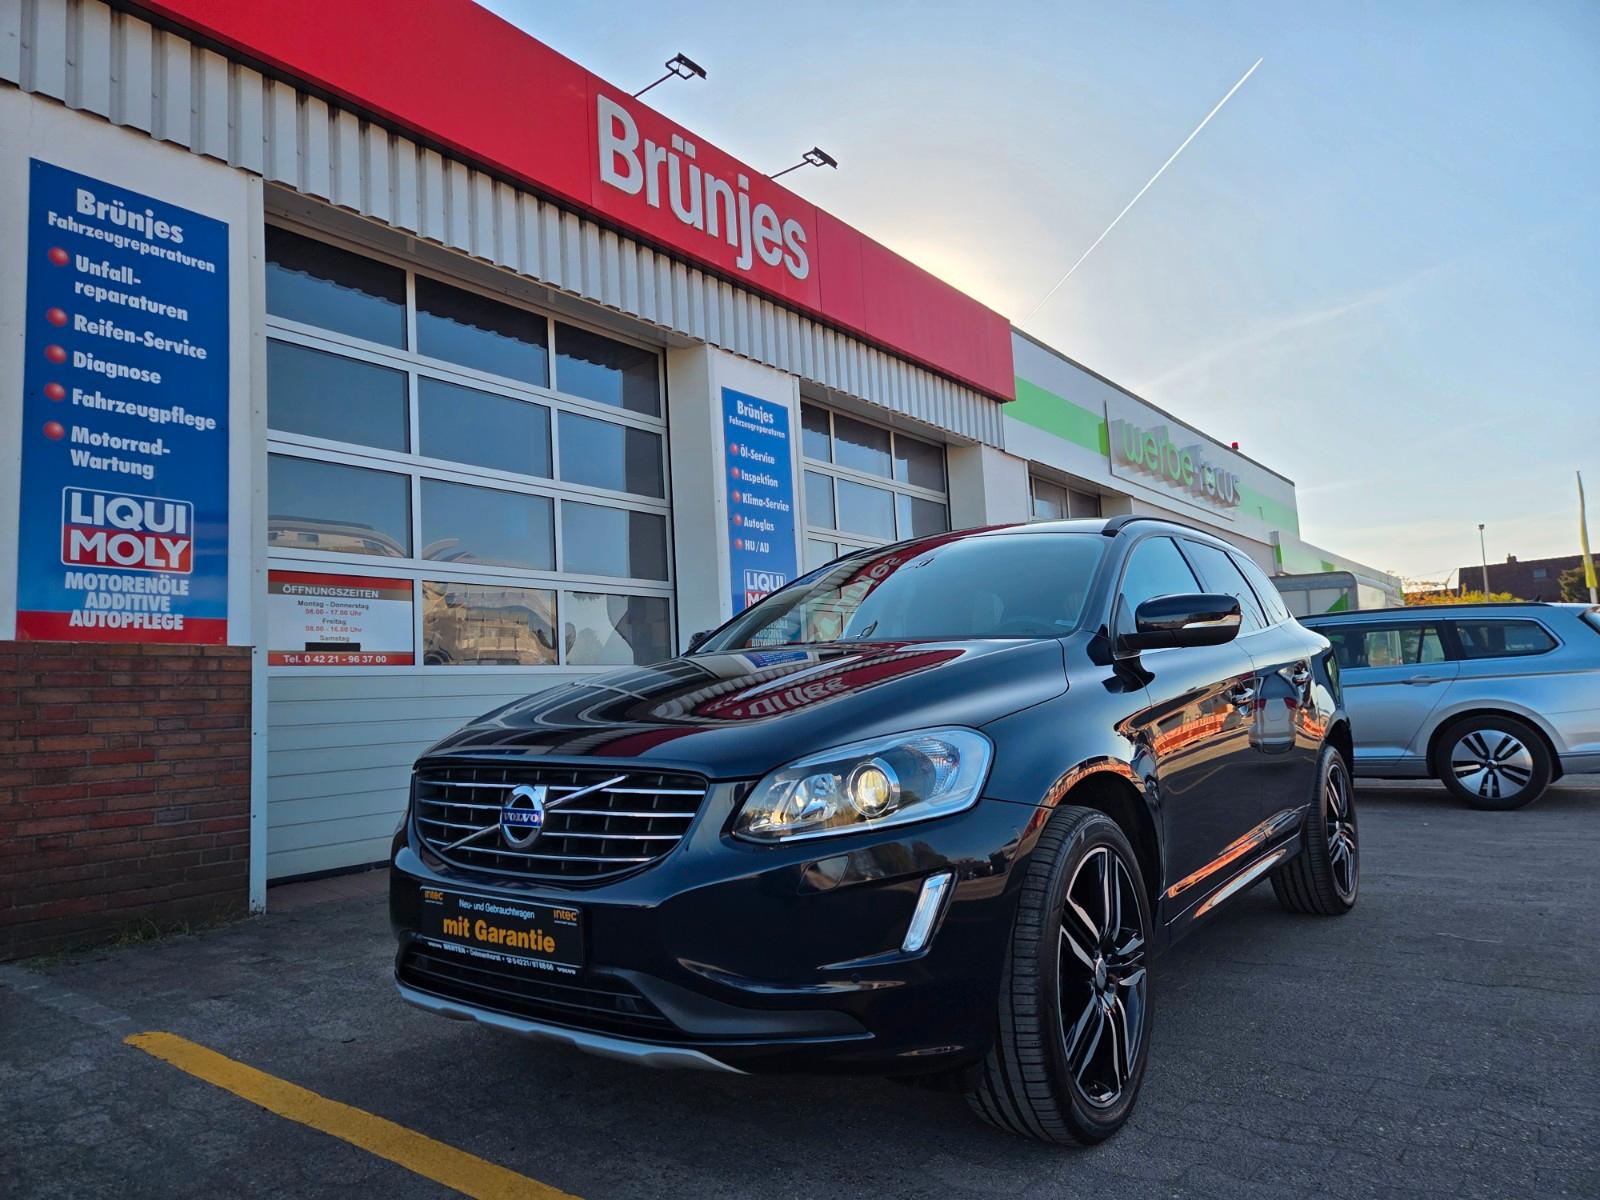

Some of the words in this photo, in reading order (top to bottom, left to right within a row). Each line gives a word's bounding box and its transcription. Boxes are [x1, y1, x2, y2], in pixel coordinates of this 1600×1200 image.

[597, 94, 809, 279] Brünjes
[76, 188, 184, 244] Brünjes
[48, 211, 216, 273] Fahrzeugreparaturen
[75, 255, 141, 285] Unfall-
[74, 281, 189, 321] reparaturen
[74, 314, 208, 360] Reifen-Service
[73, 351, 162, 384] Diagnose
[72, 388, 216, 431] Fahrzeugpflege
[736, 400, 774, 424] Brünjes
[71, 425, 170, 456] Motorrad-
[70, 449, 155, 480] Wartung
[740, 443, 775, 465] Öl-Service
[741, 469, 778, 488] Inspektion
[71, 492, 186, 534] LIQUI
[742, 492, 790, 512] Klima-Service
[743, 516, 775, 532] Autoglas
[70, 530, 190, 569] MOLY
[64, 571, 190, 595] MOTORENÖLE
[282, 584, 379, 598] ÖFFNUNGSZEITEN
[746, 572, 784, 593] LIQUI
[85, 592, 170, 612] ADDITIVE
[297, 600, 324, 609] Montag
[330, 601, 369, 610] Donnerstag
[69, 610, 184, 631] AUTOPFLEGE
[322, 618, 347, 626] Freitag
[320, 634, 350, 642] Samstag
[283, 655, 301, 663] Tel.
[304, 655, 311, 663] 0
[313, 655, 327, 663] 42
[328, 655, 339, 663] 21
[348, 655, 360, 663] 96
[363, 655, 374, 663] 37
[503, 812, 539, 823] VOLVO
[473, 902, 484, 912] und
[553, 909, 577, 922] intec
[443, 916, 470, 938] mit
[474, 919, 556, 953] Garantie
